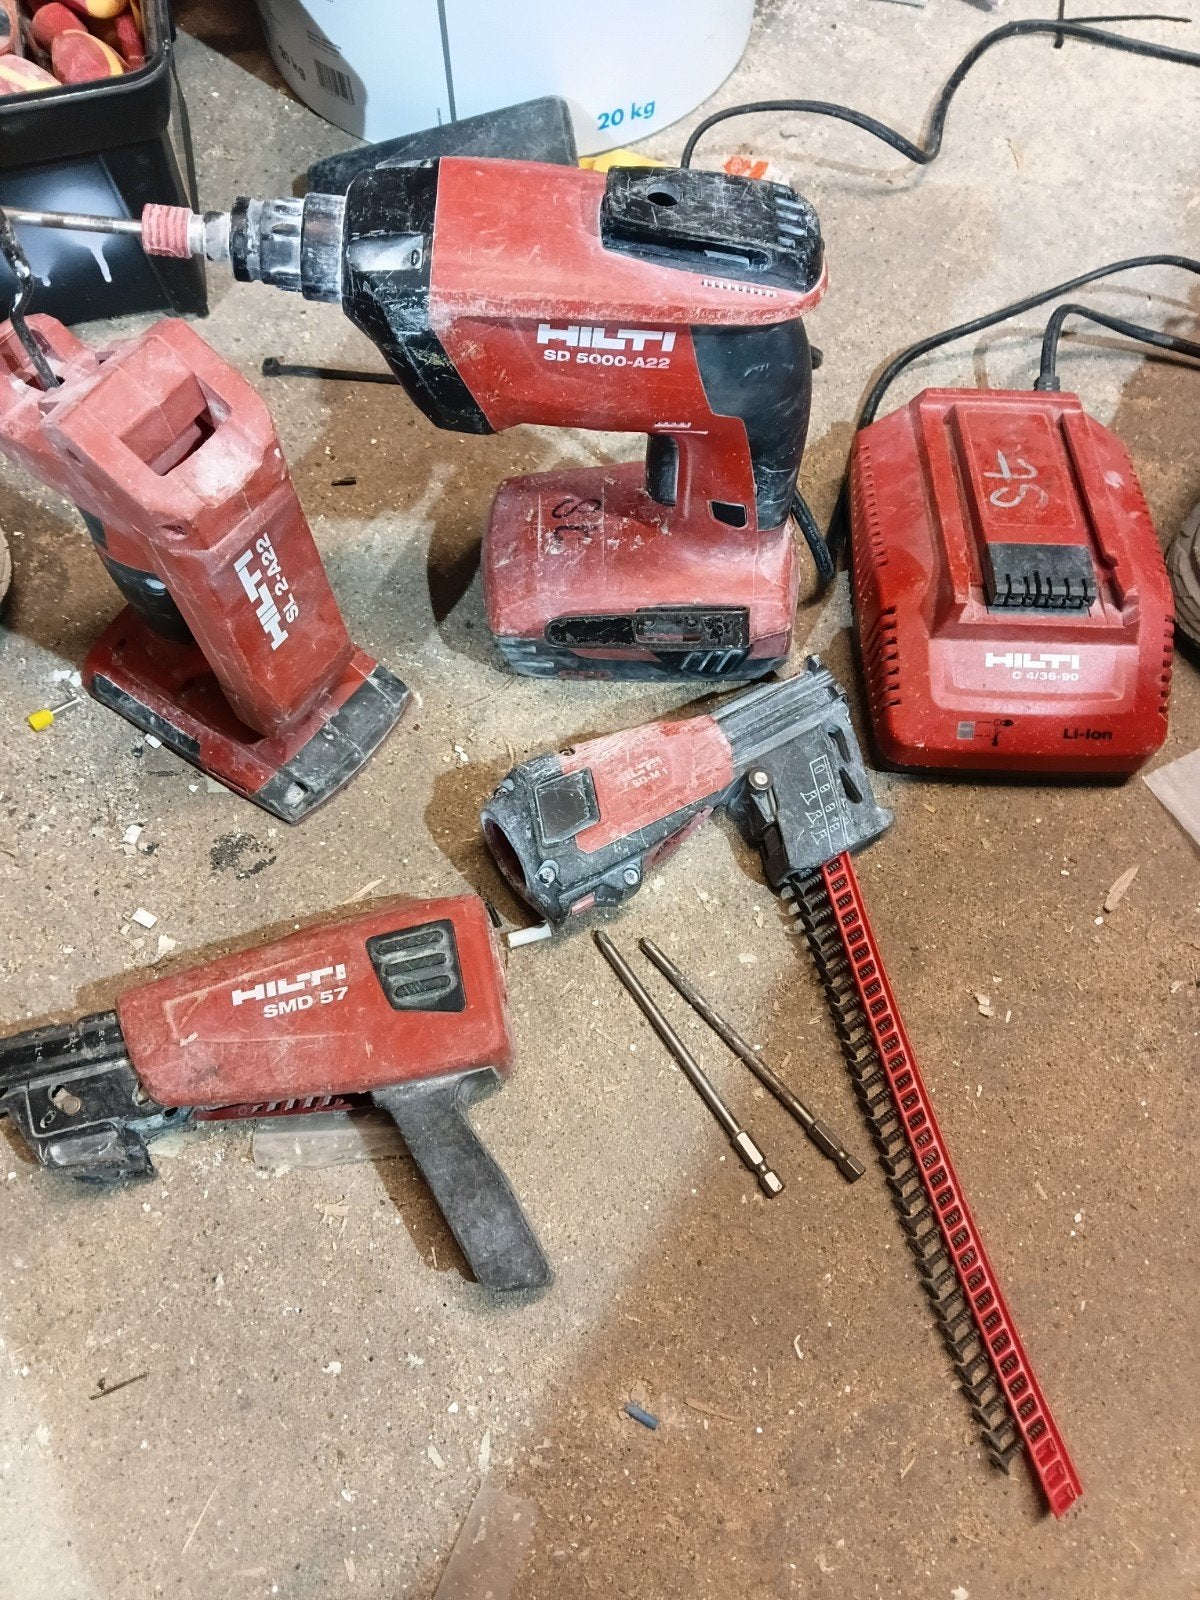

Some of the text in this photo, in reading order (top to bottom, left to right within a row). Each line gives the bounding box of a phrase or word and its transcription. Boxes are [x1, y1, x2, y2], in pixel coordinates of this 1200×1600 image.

[597, 100, 656, 131] 20 kg
[536, 323, 677, 352] HILTI
[543, 349, 671, 369] SD 5000-A22
[255, 532, 299, 624] SL 2-A22
[233, 548, 289, 651] HILTI
[985, 652, 1080, 670] HILTI
[1012, 671, 1079, 681] C 4/36-90
[1063, 728, 1113, 740] Li-Ion
[631, 769, 661, 787] SD-M
[231, 963, 347, 1007] HILTI
[263, 986, 348, 1018] SMD 57
